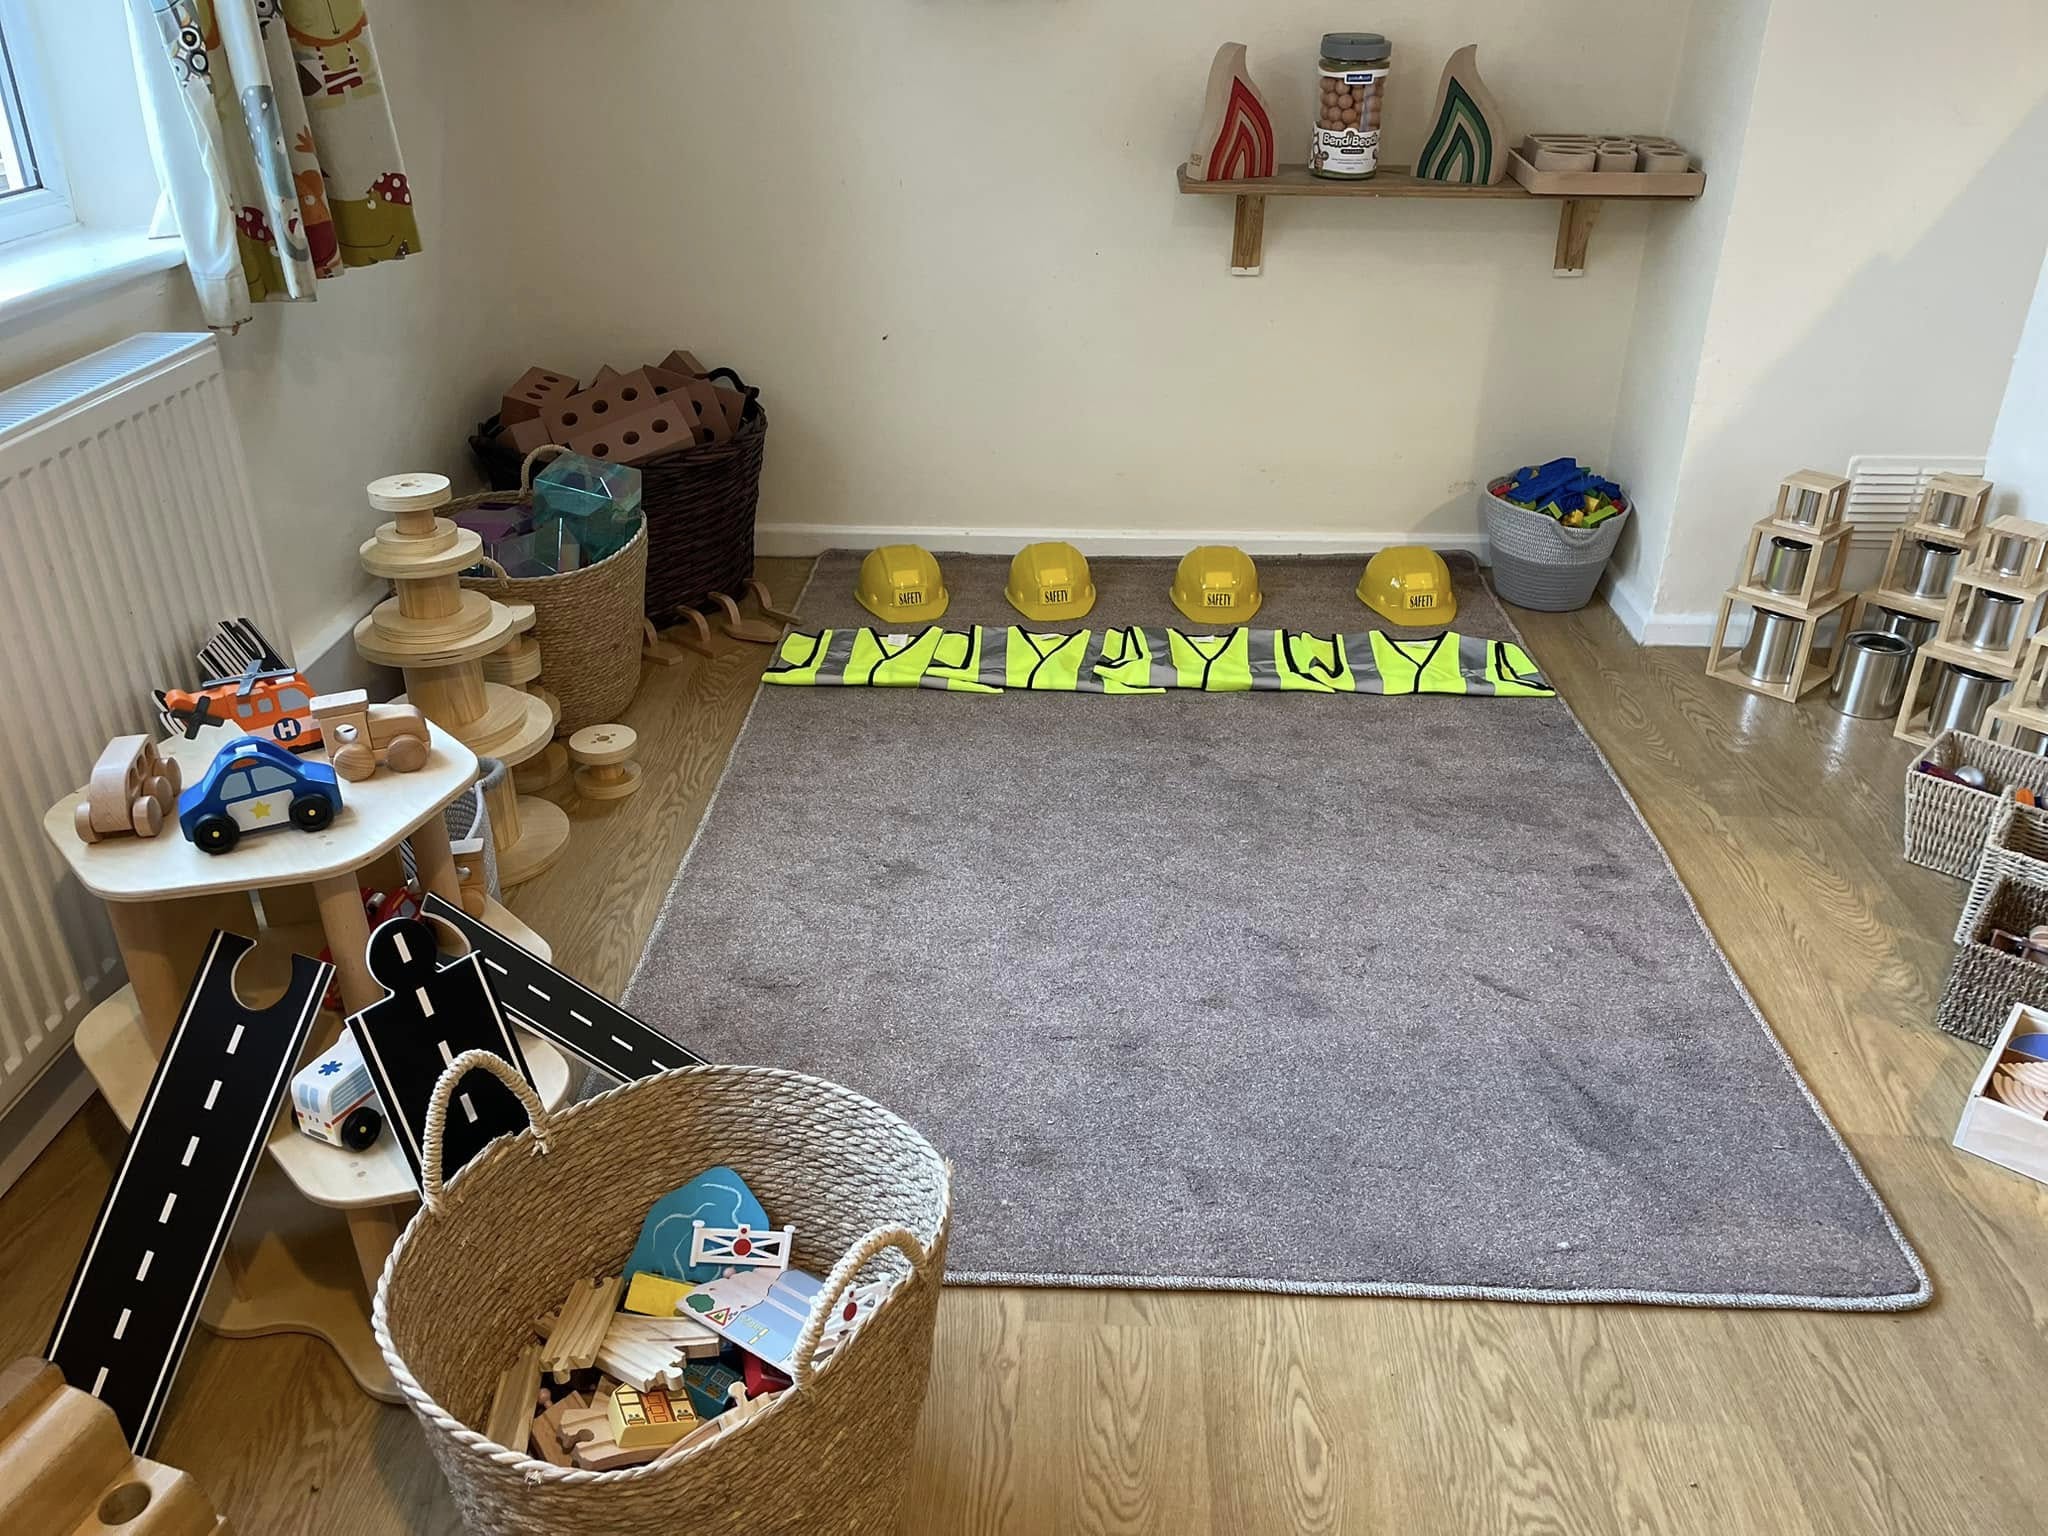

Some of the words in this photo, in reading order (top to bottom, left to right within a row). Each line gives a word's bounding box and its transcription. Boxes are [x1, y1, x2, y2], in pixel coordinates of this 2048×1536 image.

[899, 591, 923, 605] SAFETY
[1044, 590, 1069, 603] SAFETY
[1207, 593, 1231, 606] SAFETY
[1409, 594, 1433, 608] SAFETY
[277, 719, 297, 739] H
